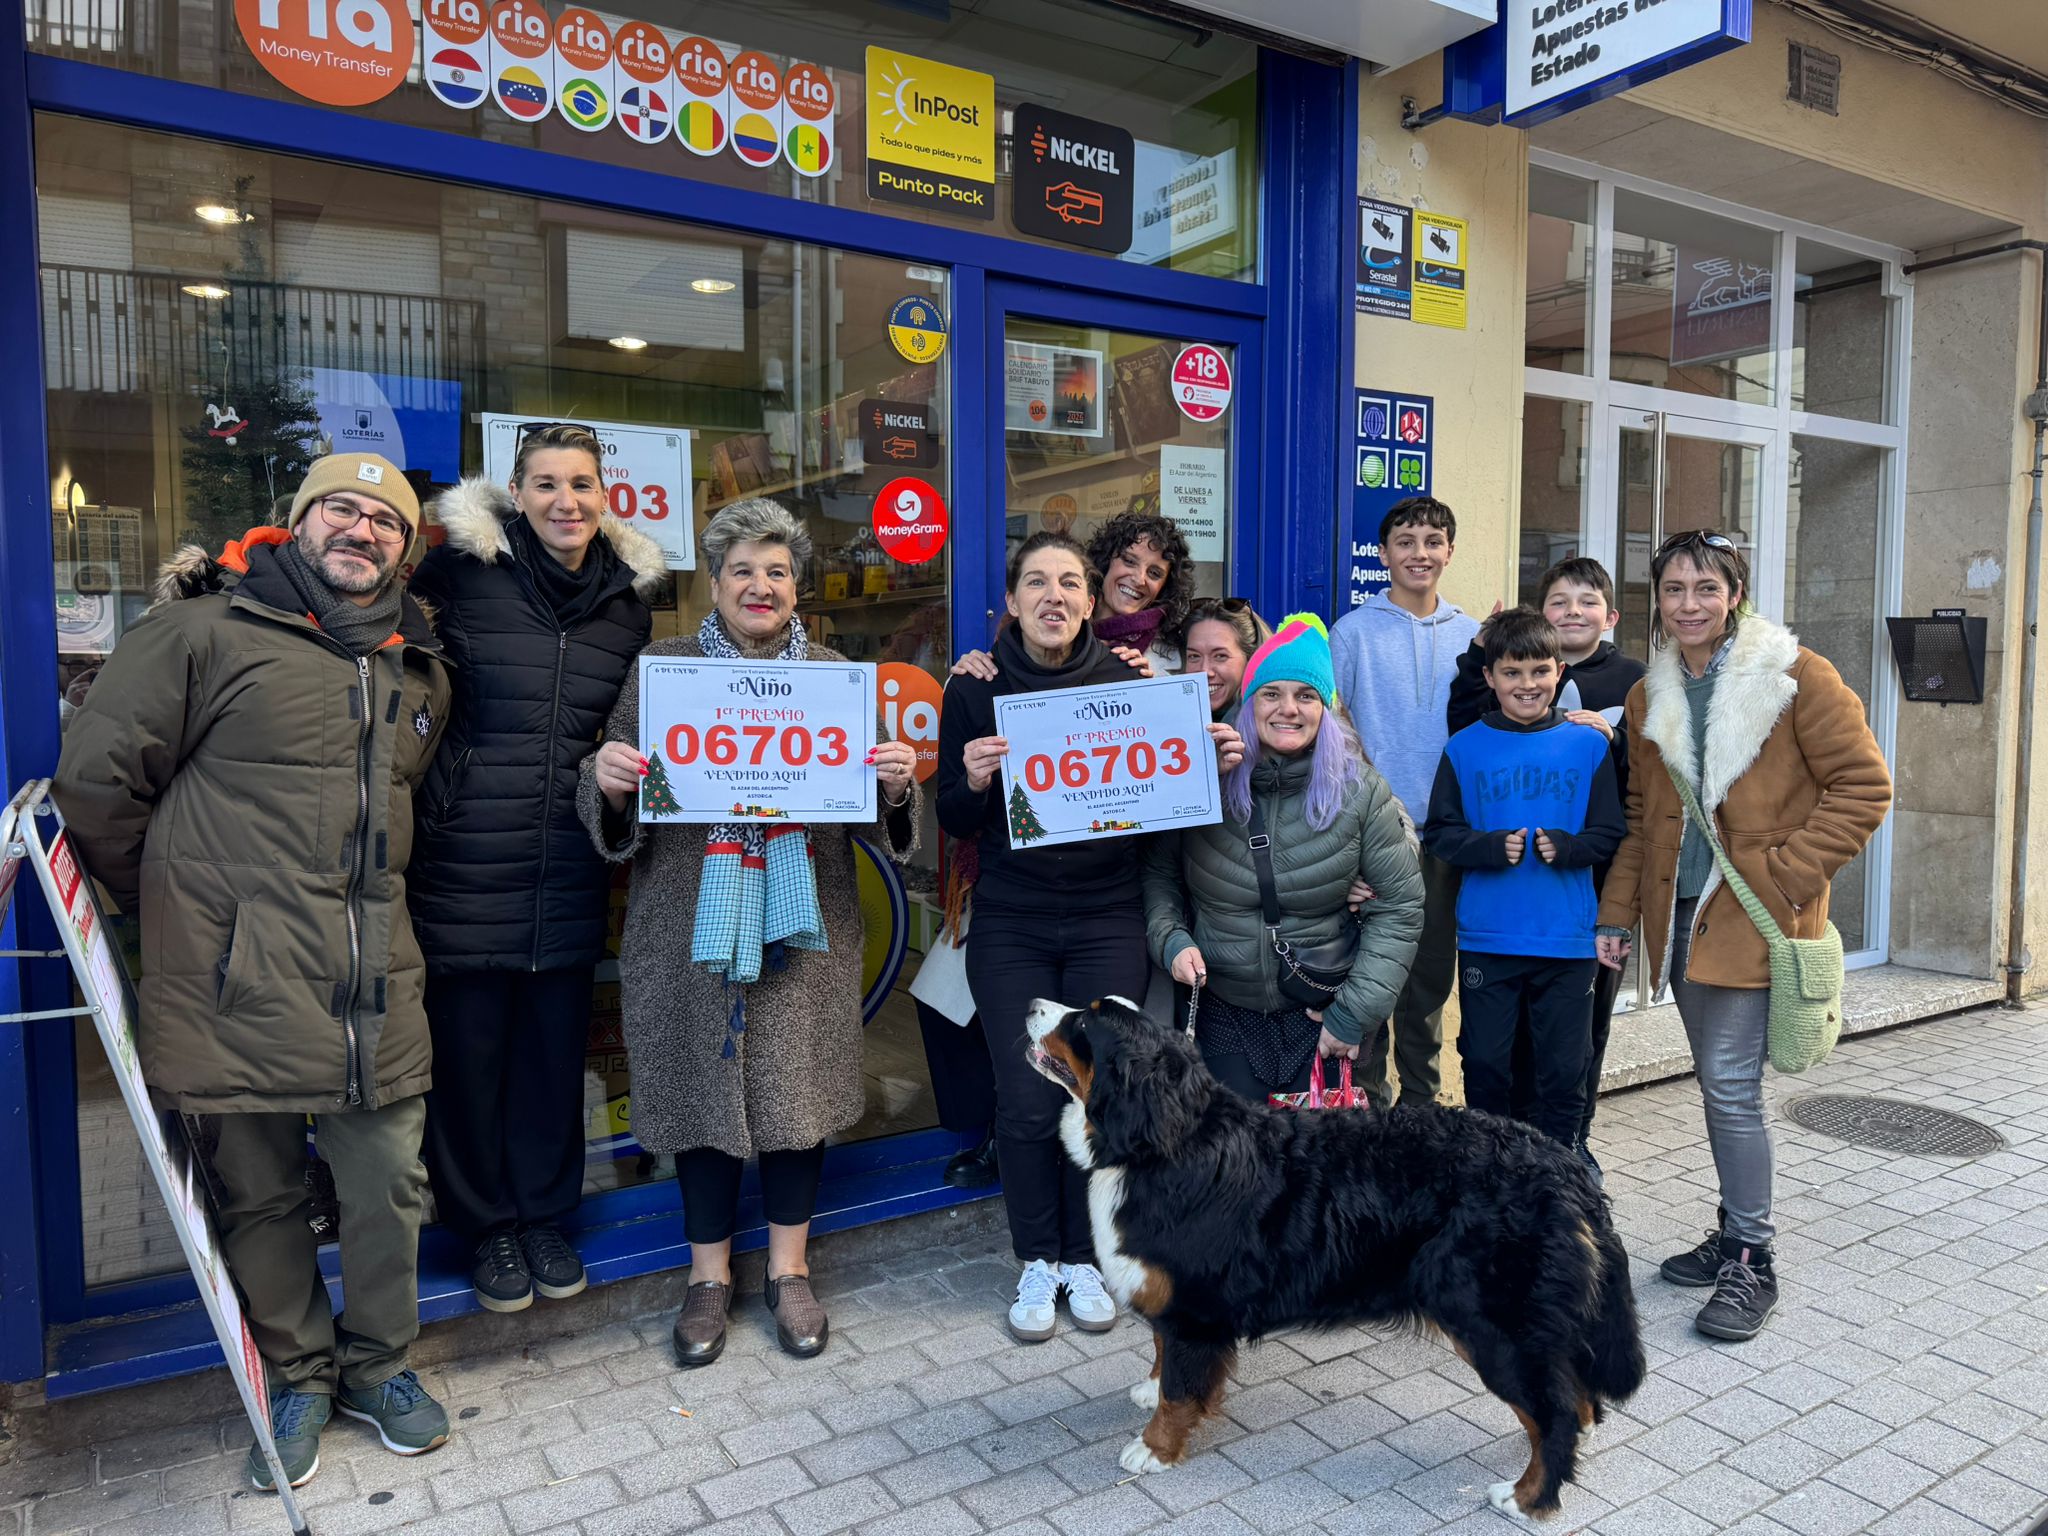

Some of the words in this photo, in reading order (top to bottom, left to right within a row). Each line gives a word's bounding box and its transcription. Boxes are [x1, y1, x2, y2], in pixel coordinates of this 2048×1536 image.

[431, 0, 480, 25] ria
[498, 1, 545, 39] ria
[431, 18, 454, 31] Money
[454, 22, 481, 34] Transfer
[561, 16, 606, 51] ria
[1532, 1, 1628, 58] Apuestas
[498, 33, 520, 43] Money
[520, 37, 545, 48] Transfer
[621, 28, 666, 65] ria
[260, 38, 322, 67] Money
[323, 51, 393, 78] Transfer
[561, 45, 582, 57] Money
[582, 50, 606, 62] Transfer
[680, 44, 722, 80] ria
[621, 58, 642, 70] Money
[641, 62, 665, 74] Transfer
[1531, 42, 1601, 87] Estado
[680, 72, 700, 83] Money
[699, 77, 722, 88] Transfer
[736, 58, 776, 92] ria
[736, 86, 755, 97] Money
[754, 90, 776, 101] Transfer
[790, 70, 828, 104] ria
[790, 97, 807, 107] Money
[806, 100, 828, 112] Transfer
[914, 91, 979, 127] InPost
[880, 136, 903, 148] Todo
[904, 141, 912, 150] lo
[914, 144, 931, 153] que
[932, 148, 956, 159] pides
[956, 154, 963, 162] y
[963, 155, 982, 165] más
[879, 171, 935, 196] Punto
[938, 183, 984, 206] Pack
[1359, 200, 1373, 209] ZONA
[1373, 203, 1409, 216] VIDEOVIGILADA
[1431, 217, 1463, 229] VIDEOVIGILADA
[1369, 269, 1398, 283] Serastel
[1356, 295, 1396, 307] PROTEGIDO
[1008, 360, 1048, 371] CALENDARIO
[1008, 368, 1042, 377] SOLIDARIO
[1185, 352, 1218, 379] +18
[1025, 378, 1050, 386] TABUYO
[1031, 405, 1047, 415] 10€
[342, 428, 385, 438] LOTERÍAS
[602, 466, 629, 479] MIO
[1174, 486, 1183, 494] DE
[1184, 487, 1206, 495] LUNES
[1178, 496, 1207, 504] VIERNES
[1352, 541, 1379, 557] Lote
[1351, 566, 1392, 585] Apuest
[727, 682, 740, 693] El
[739, 676, 792, 698] Niño
[716, 707, 734, 720] 1er
[737, 707, 804, 722] PREMIO
[883, 678, 938, 741] ia
[1073, 709, 1085, 719] El
[1084, 700, 1132, 720] Niño
[1065, 732, 1081, 746] 1er
[1084, 725, 1146, 744] PREMIO
[665, 723, 849, 767] 06703
[916, 749, 938, 761] sfer
[1024, 737, 1191, 793] 06703
[703, 769, 769, 782] VENDIDO
[771, 768, 807, 783] AQUÍ
[1474, 764, 1581, 803] ADIDAS
[1062, 788, 1120, 803] VENDIDO
[1121, 781, 1155, 797] AQUÍ
